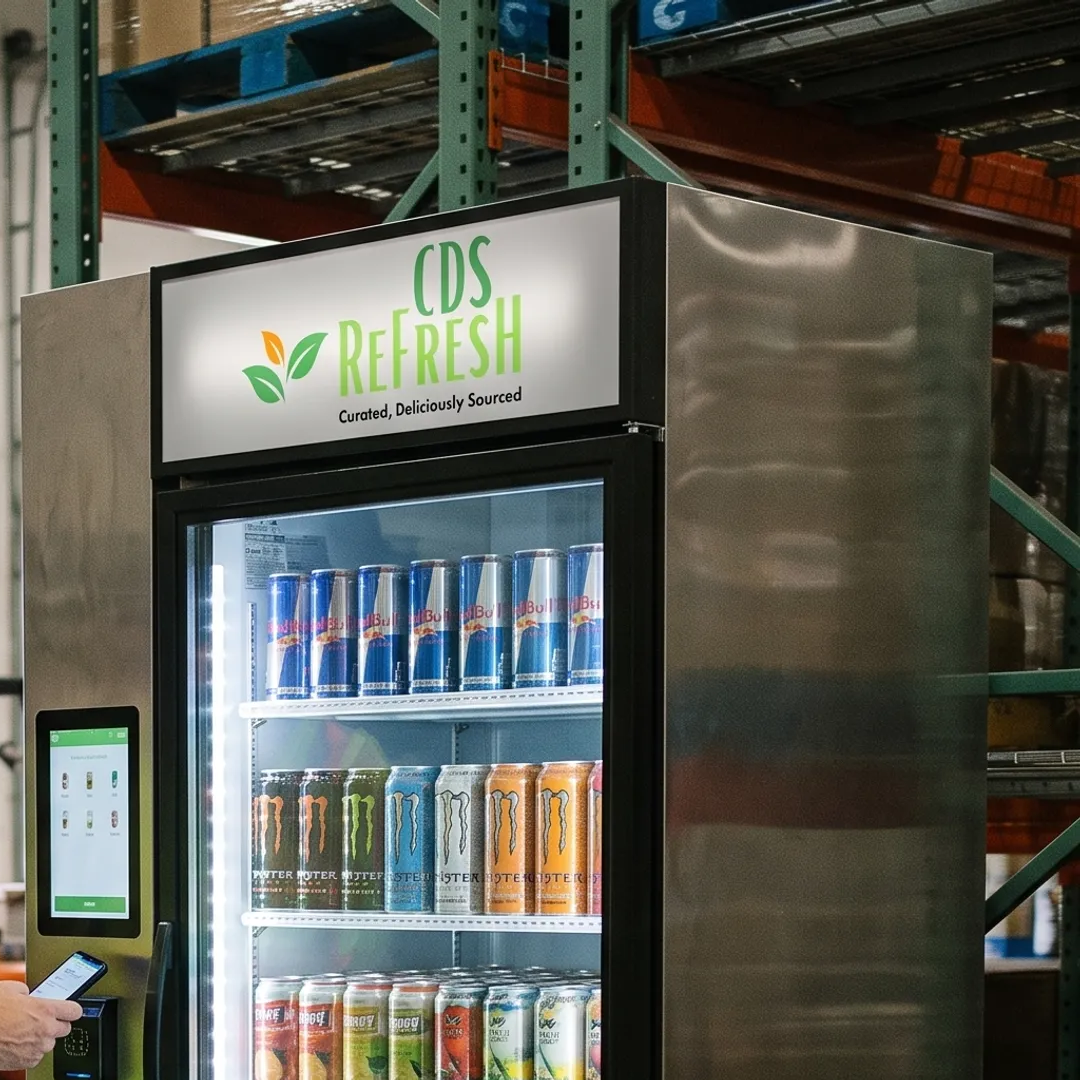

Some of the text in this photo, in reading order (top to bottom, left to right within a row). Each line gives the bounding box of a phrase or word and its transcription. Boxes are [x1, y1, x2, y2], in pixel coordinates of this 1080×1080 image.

[413, 235, 492, 317] CDS
[338, 385, 523, 424] Curated, Deliciously Sourced
